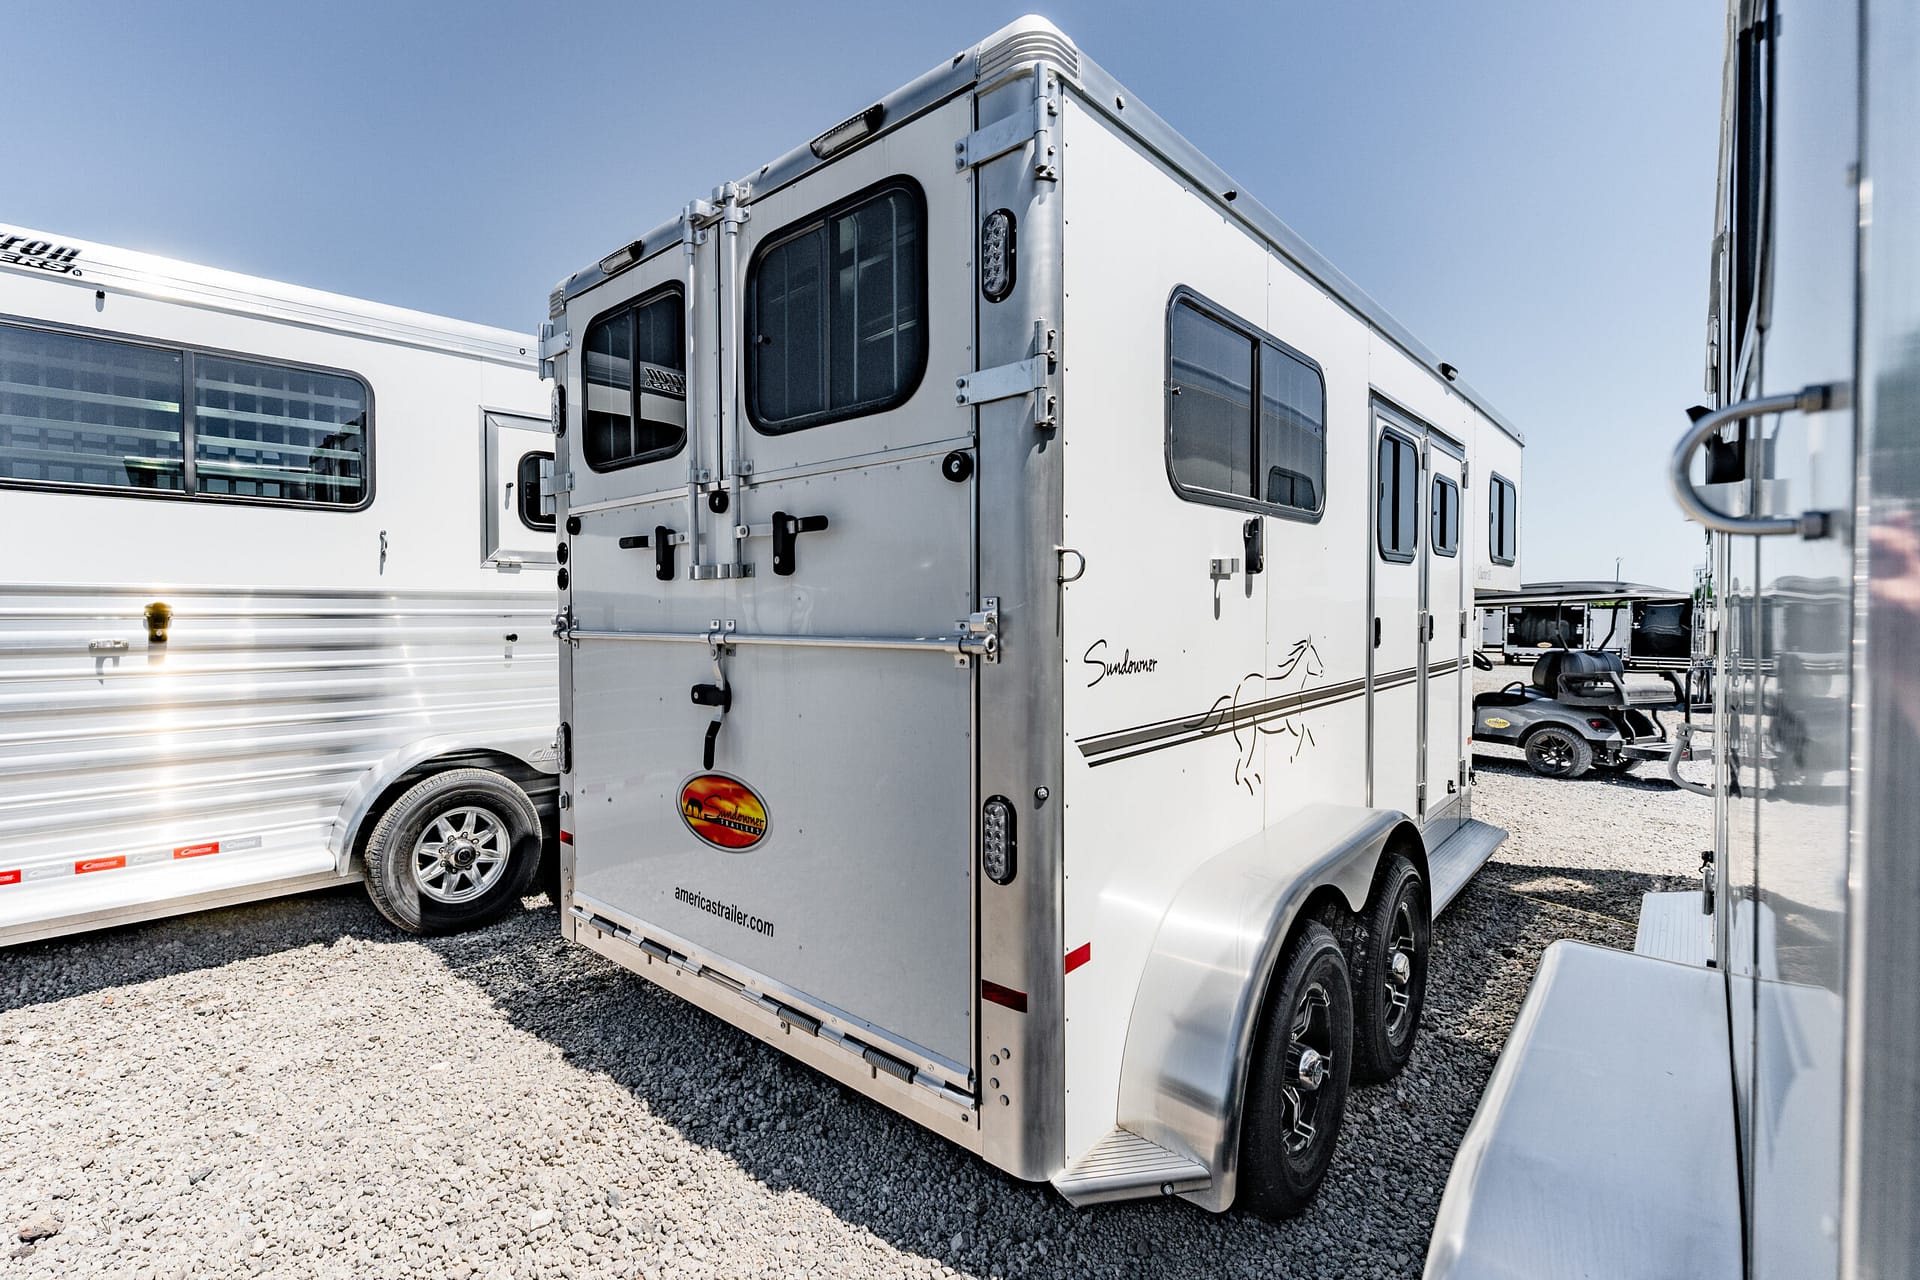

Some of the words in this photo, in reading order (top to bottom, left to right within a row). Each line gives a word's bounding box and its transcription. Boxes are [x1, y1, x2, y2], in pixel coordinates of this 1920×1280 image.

[1083, 639, 1158, 688] Sundowner
[704, 794, 764, 827] Sundowner
[721, 818, 760, 835] TRAILERS
[674, 886, 774, 937] americastrailer.com
